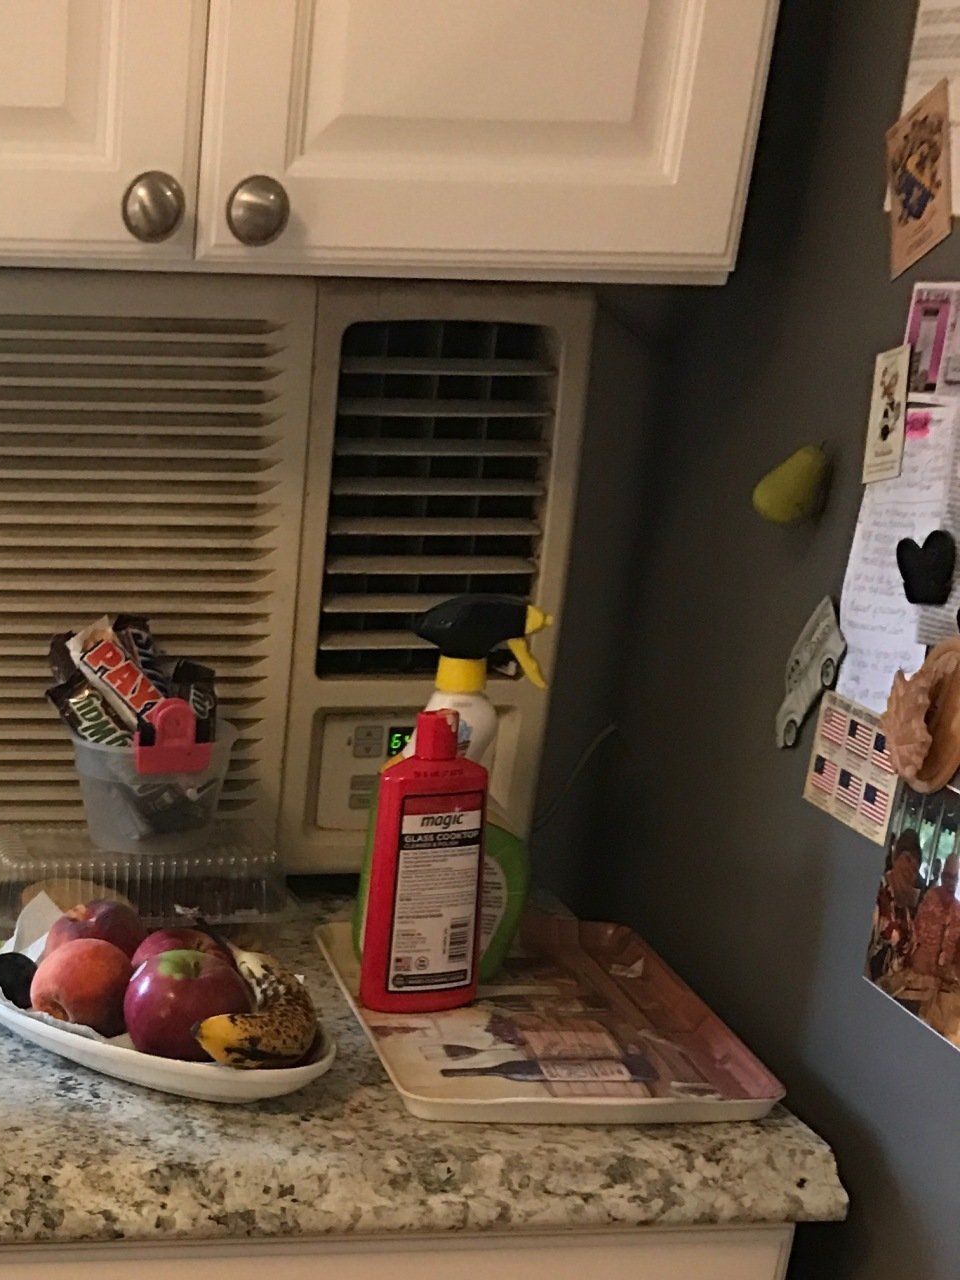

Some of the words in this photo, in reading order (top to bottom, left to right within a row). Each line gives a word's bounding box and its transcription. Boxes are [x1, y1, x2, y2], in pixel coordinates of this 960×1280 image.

[81, 639, 166, 715] PAY
[420, 812, 464, 829] magic
[403, 833, 434, 843] GLASS
